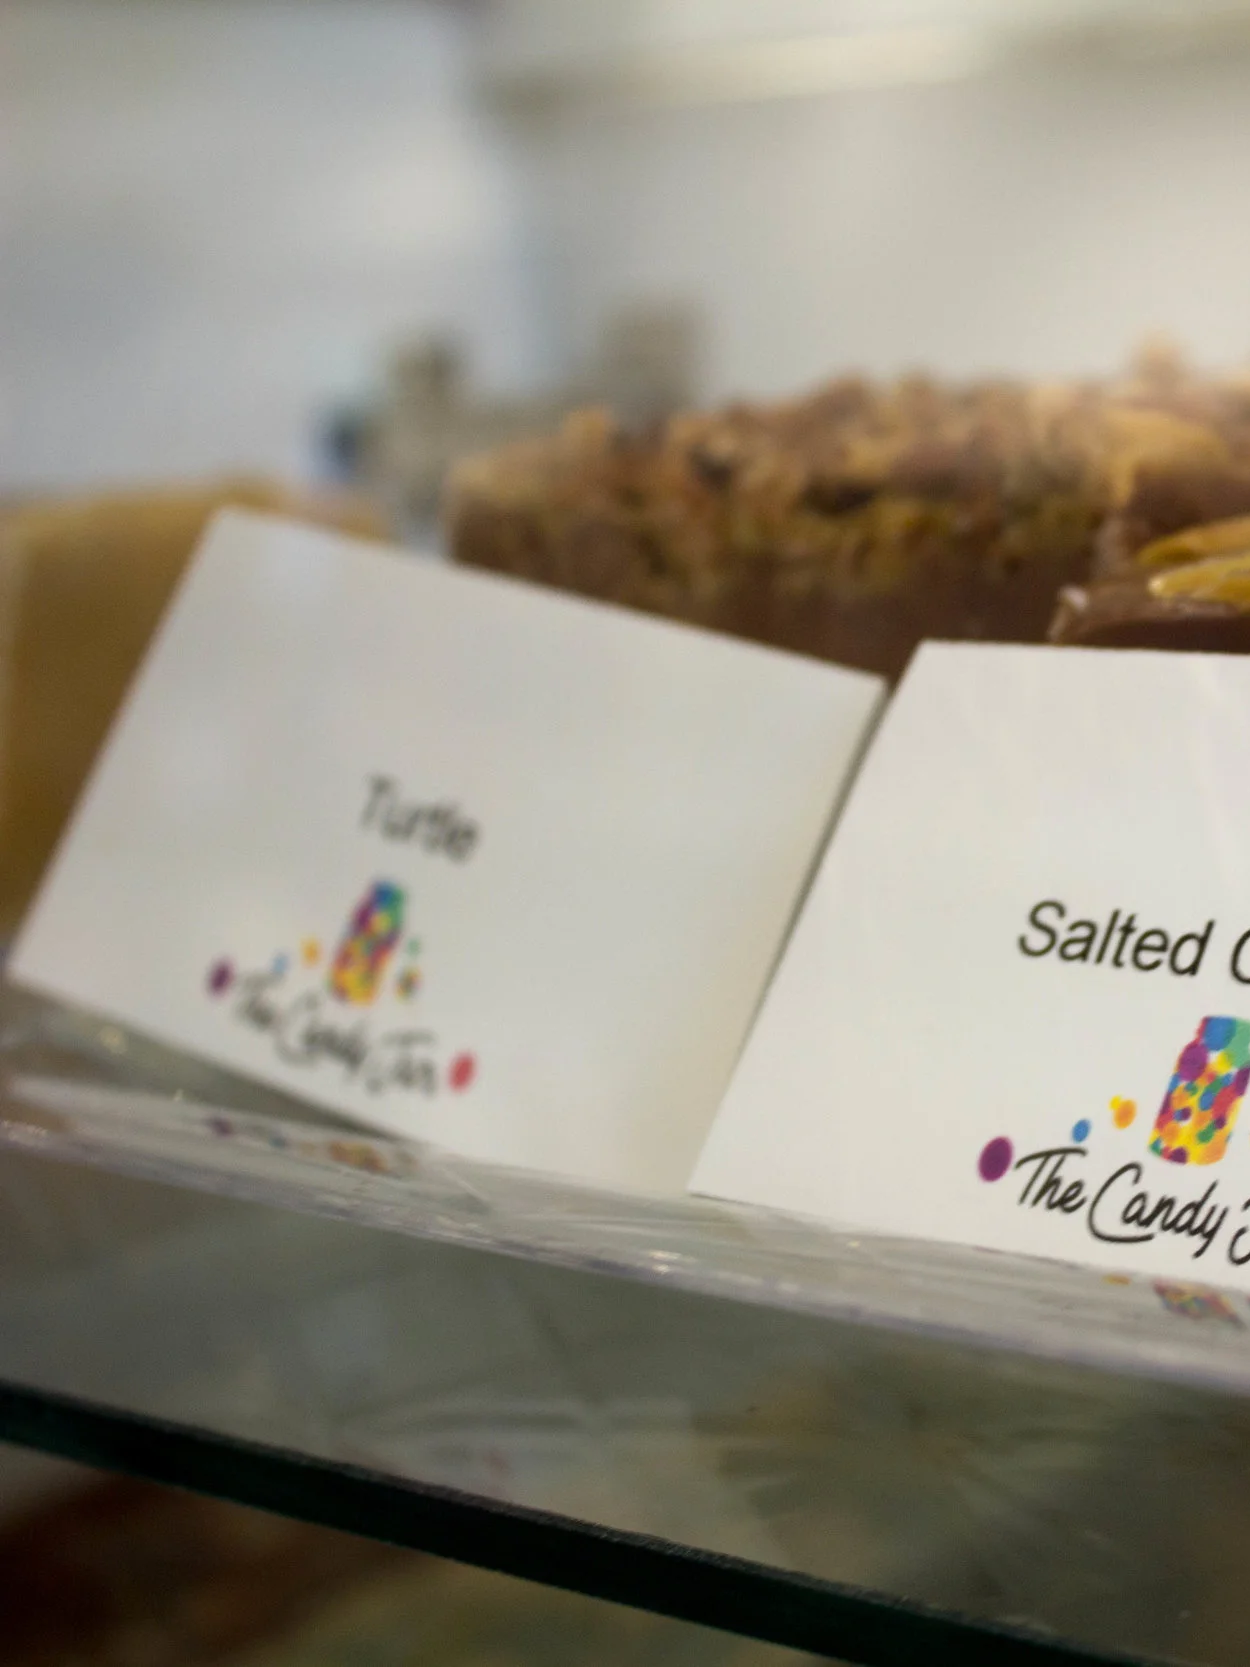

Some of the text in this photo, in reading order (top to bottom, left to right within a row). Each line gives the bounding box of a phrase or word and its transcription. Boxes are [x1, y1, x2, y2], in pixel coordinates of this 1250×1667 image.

[363, 775, 478, 863] Turtle
[1018, 899, 1215, 977] Salted
[1013, 1146, 1088, 1214] The
[1087, 1162, 1229, 1259] Candy
